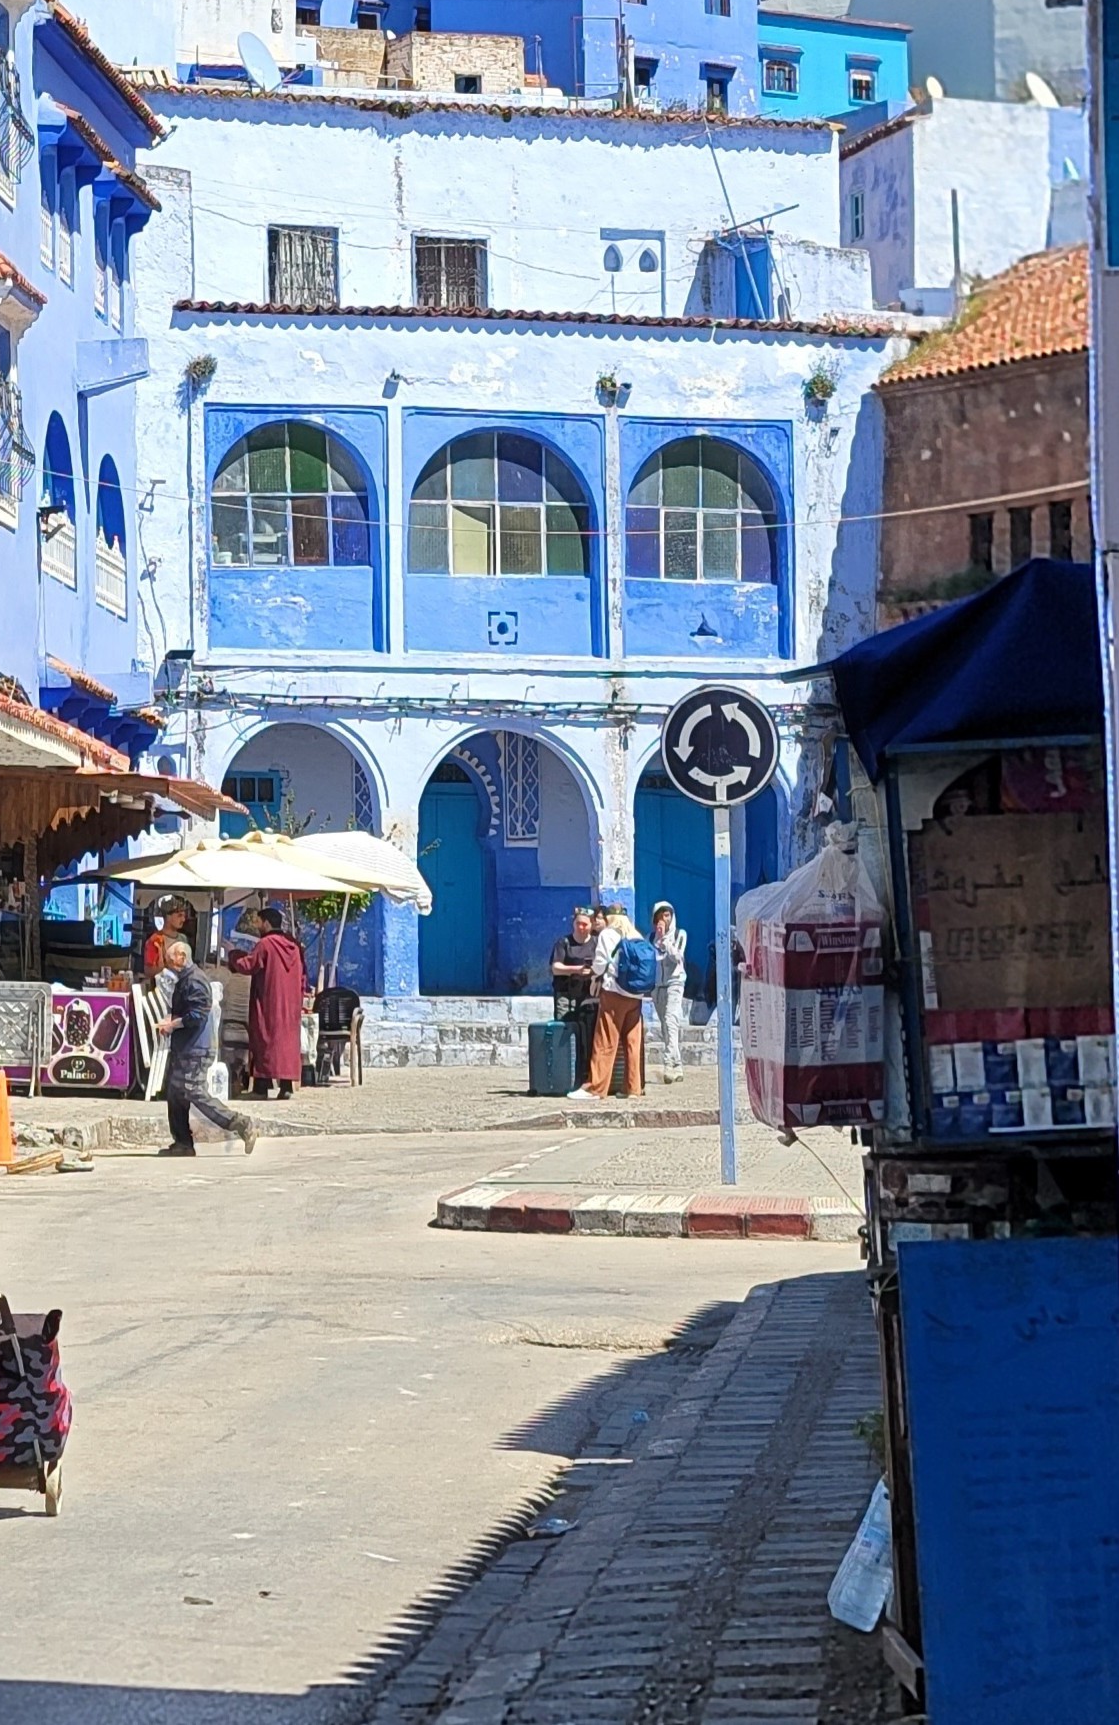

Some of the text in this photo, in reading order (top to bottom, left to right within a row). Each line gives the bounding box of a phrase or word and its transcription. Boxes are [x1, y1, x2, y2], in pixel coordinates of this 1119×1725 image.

[820, 933, 857, 947] Winston
[800, 1006, 814, 1048] Winston
[846, 1001, 862, 1049] Winston
[869, 1005, 880, 1043] Winston
[61, 1068, 97, 1080] Palacio
